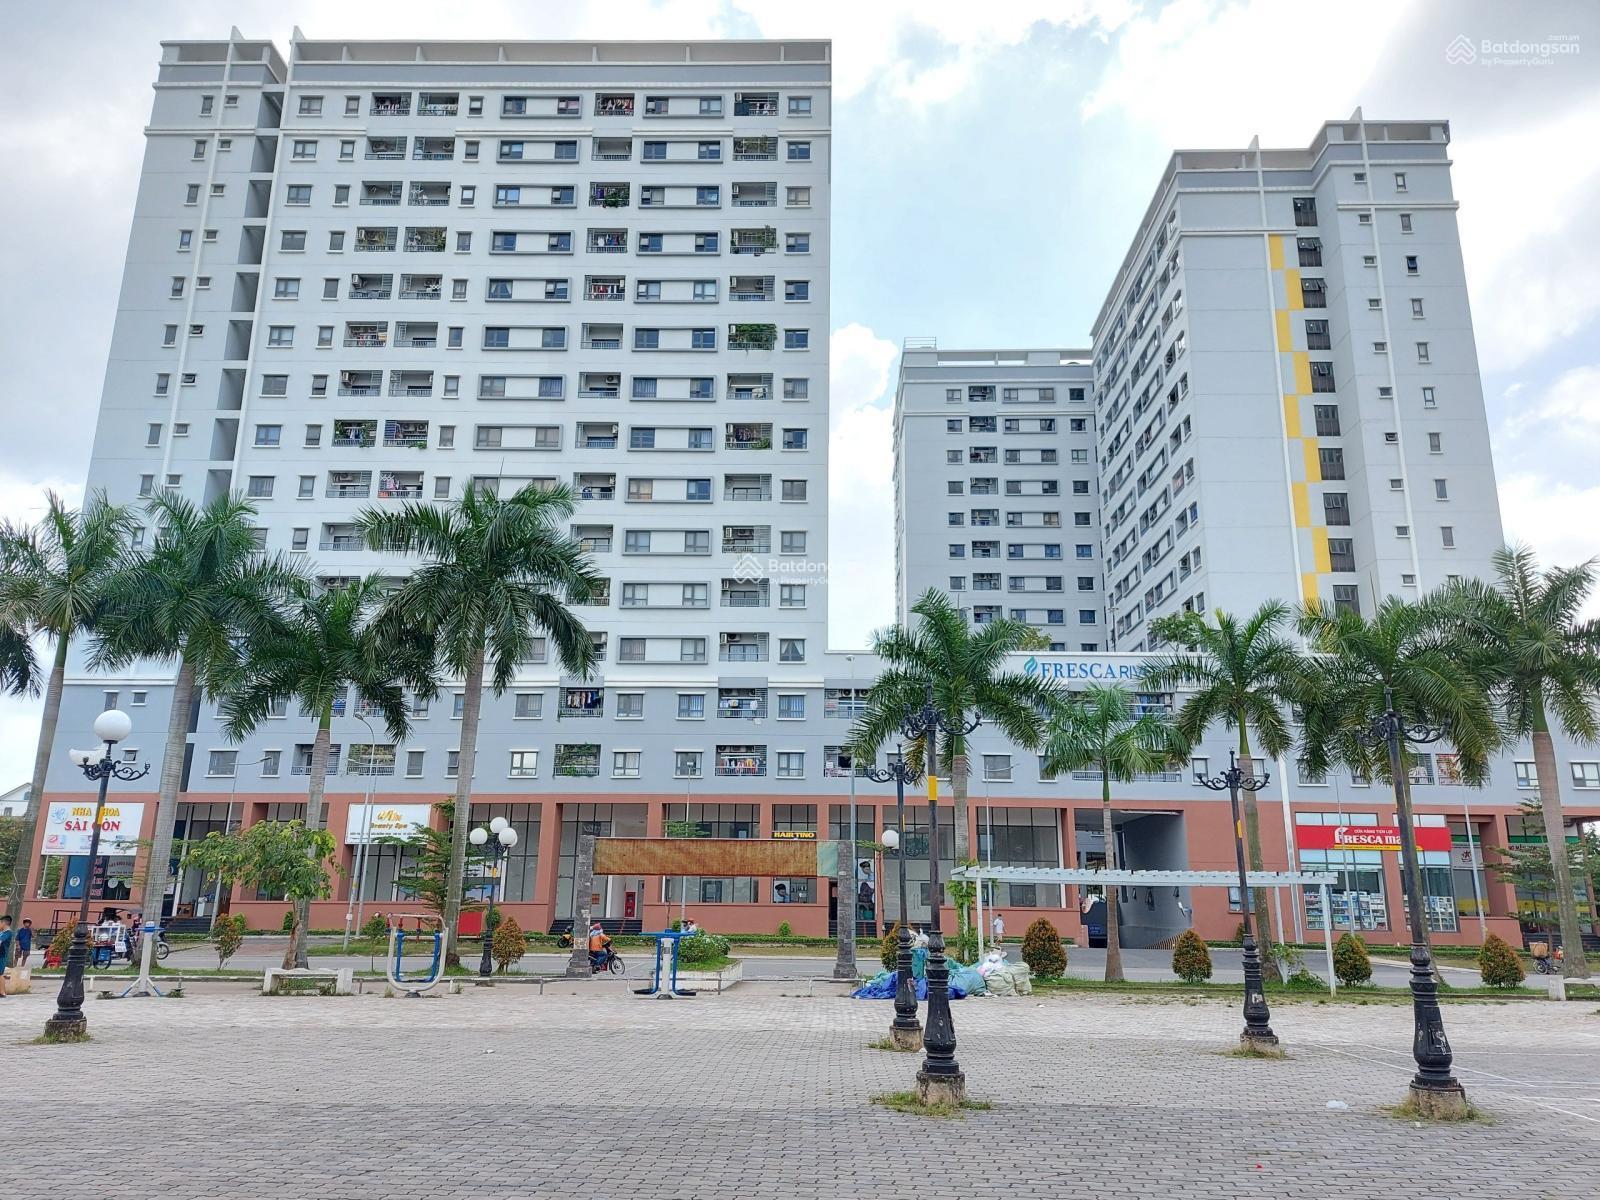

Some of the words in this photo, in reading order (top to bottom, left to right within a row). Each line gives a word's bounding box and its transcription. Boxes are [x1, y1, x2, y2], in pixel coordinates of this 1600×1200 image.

[1040, 662, 1118, 679] FRESCA
[71, 807, 92, 816] NHA
[64, 817, 88, 831] SÀI
[1334, 827, 1382, 844] FRESCA
